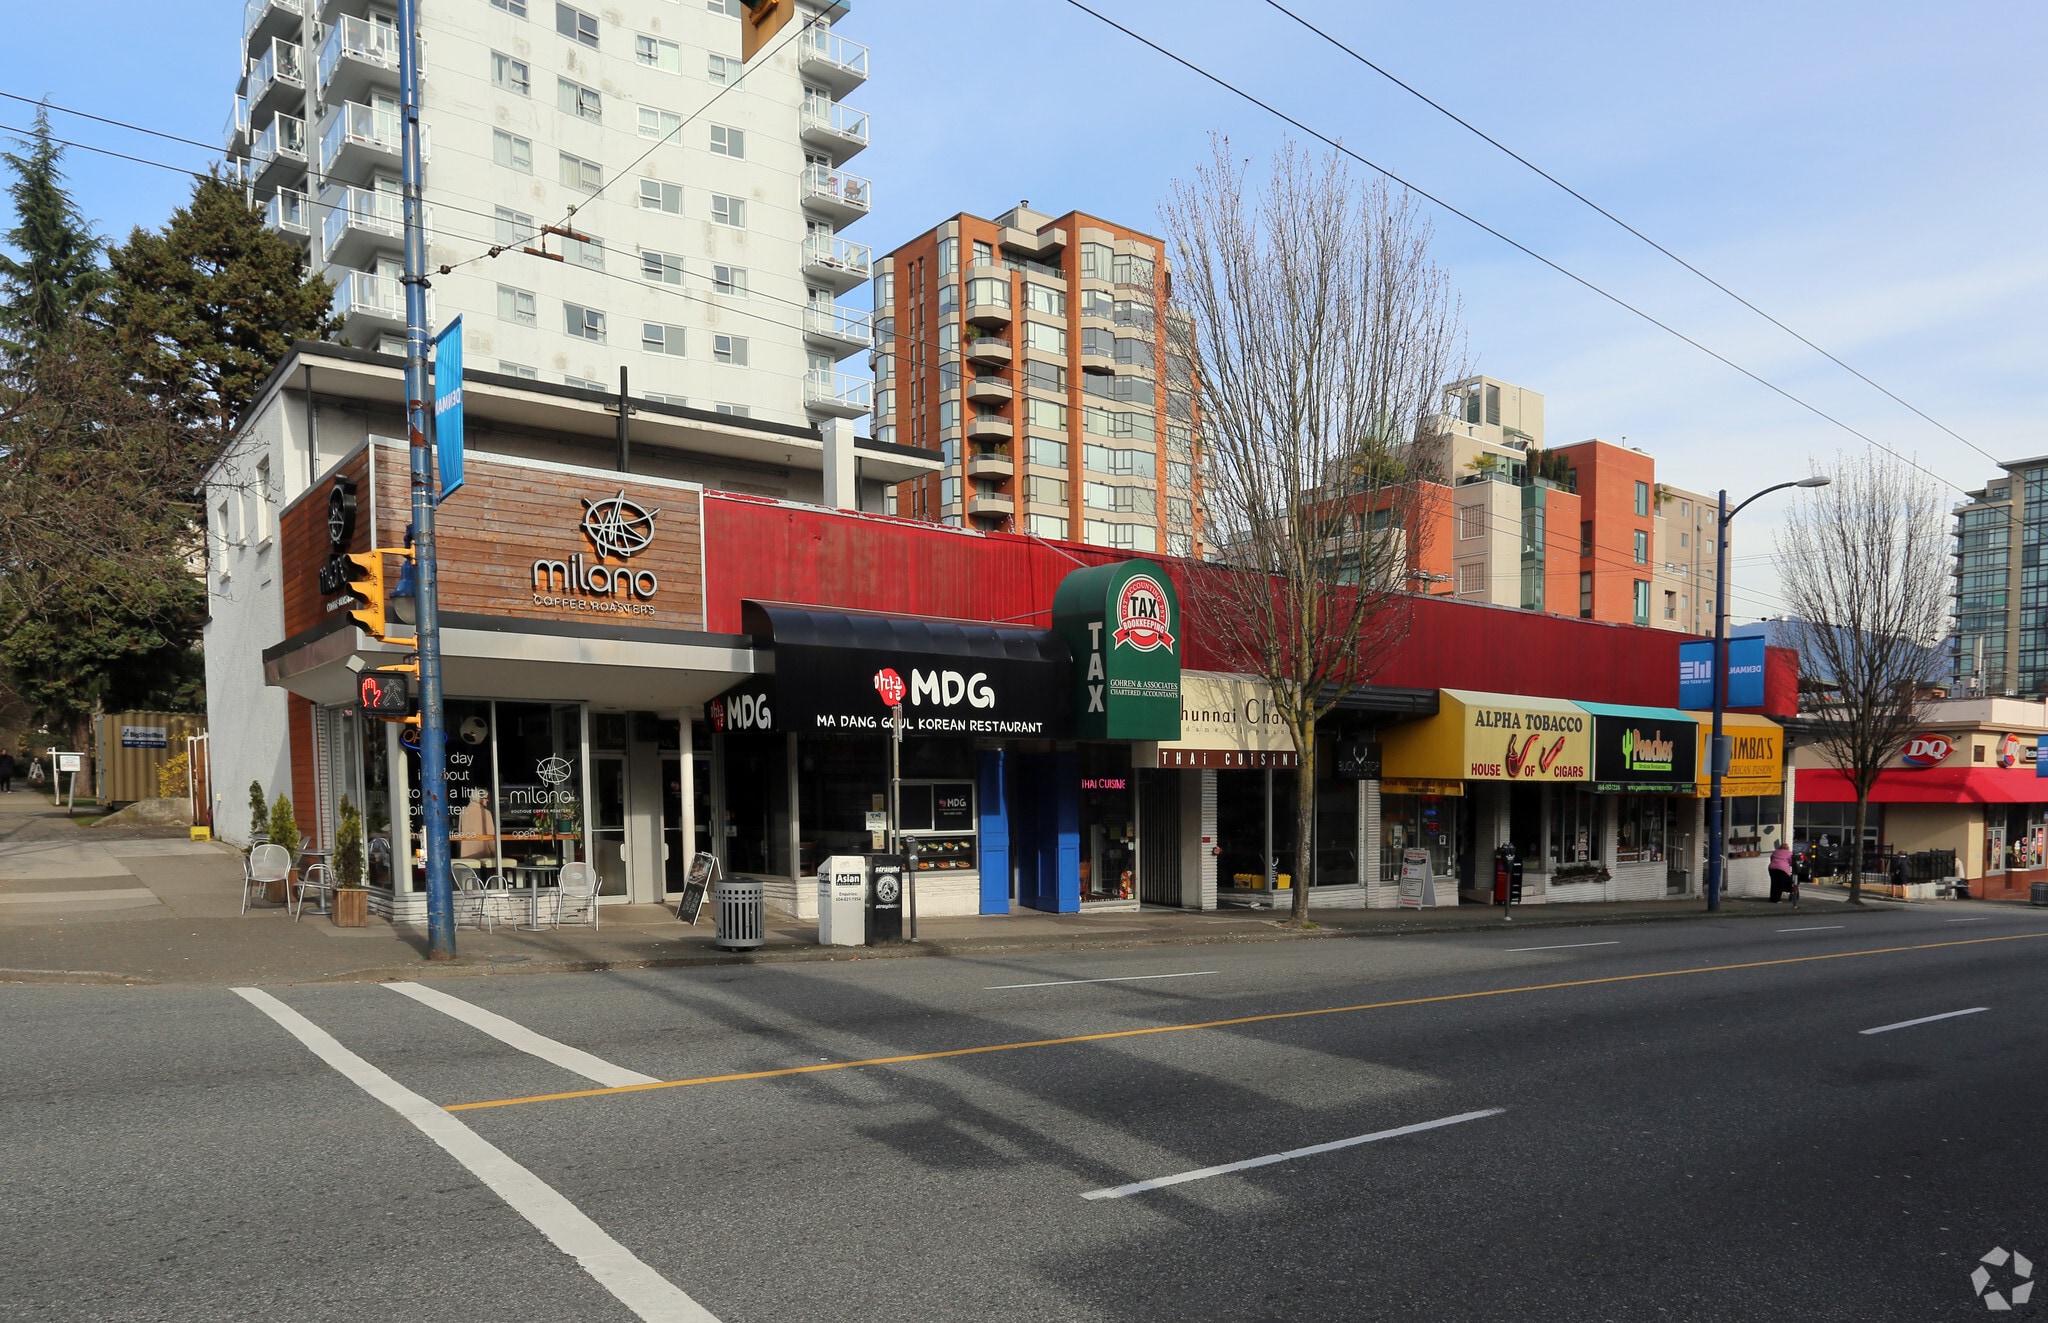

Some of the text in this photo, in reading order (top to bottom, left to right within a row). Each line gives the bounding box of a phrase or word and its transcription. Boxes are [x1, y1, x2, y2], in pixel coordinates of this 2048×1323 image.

[533, 553, 658, 597] milano
[1127, 581, 1161, 602] ACCOUNTING
[533, 594, 656, 615] COFFEE ROASTERS
[1130, 596, 1157, 618] TAX
[1122, 618, 1167, 634] BOOKKEEPING
[1087, 621, 1105, 713] TAX
[911, 668, 995, 709] MDG
[1110, 679, 1136, 687] GOHREN
[1143, 681, 1178, 690] ASSOCIATES
[1142, 690, 1178, 698] ACCOUNTANTS
[727, 694, 771, 730] MDG
[1181, 695, 1236, 722] hunnai
[817, 714, 836, 727] MA
[840, 715, 877, 728] DANG
[918, 718, 966, 731] KOREAN
[969, 719, 1042, 733] RESTAURANT
[1475, 710, 1582, 732] ALPHA TOBACCO
[1730, 737, 1773, 759] IMBA'S
[1908, 740, 1948, 759] DQ
[451, 752, 473, 766] day
[1471, 763, 1583, 777] HOUSE OF CIGARS
[1081, 778, 1126, 789] THAI CUISINE
[510, 786, 571, 803] milano
[947, 798, 967, 807] MDG
[837, 874, 860, 884] Asian
